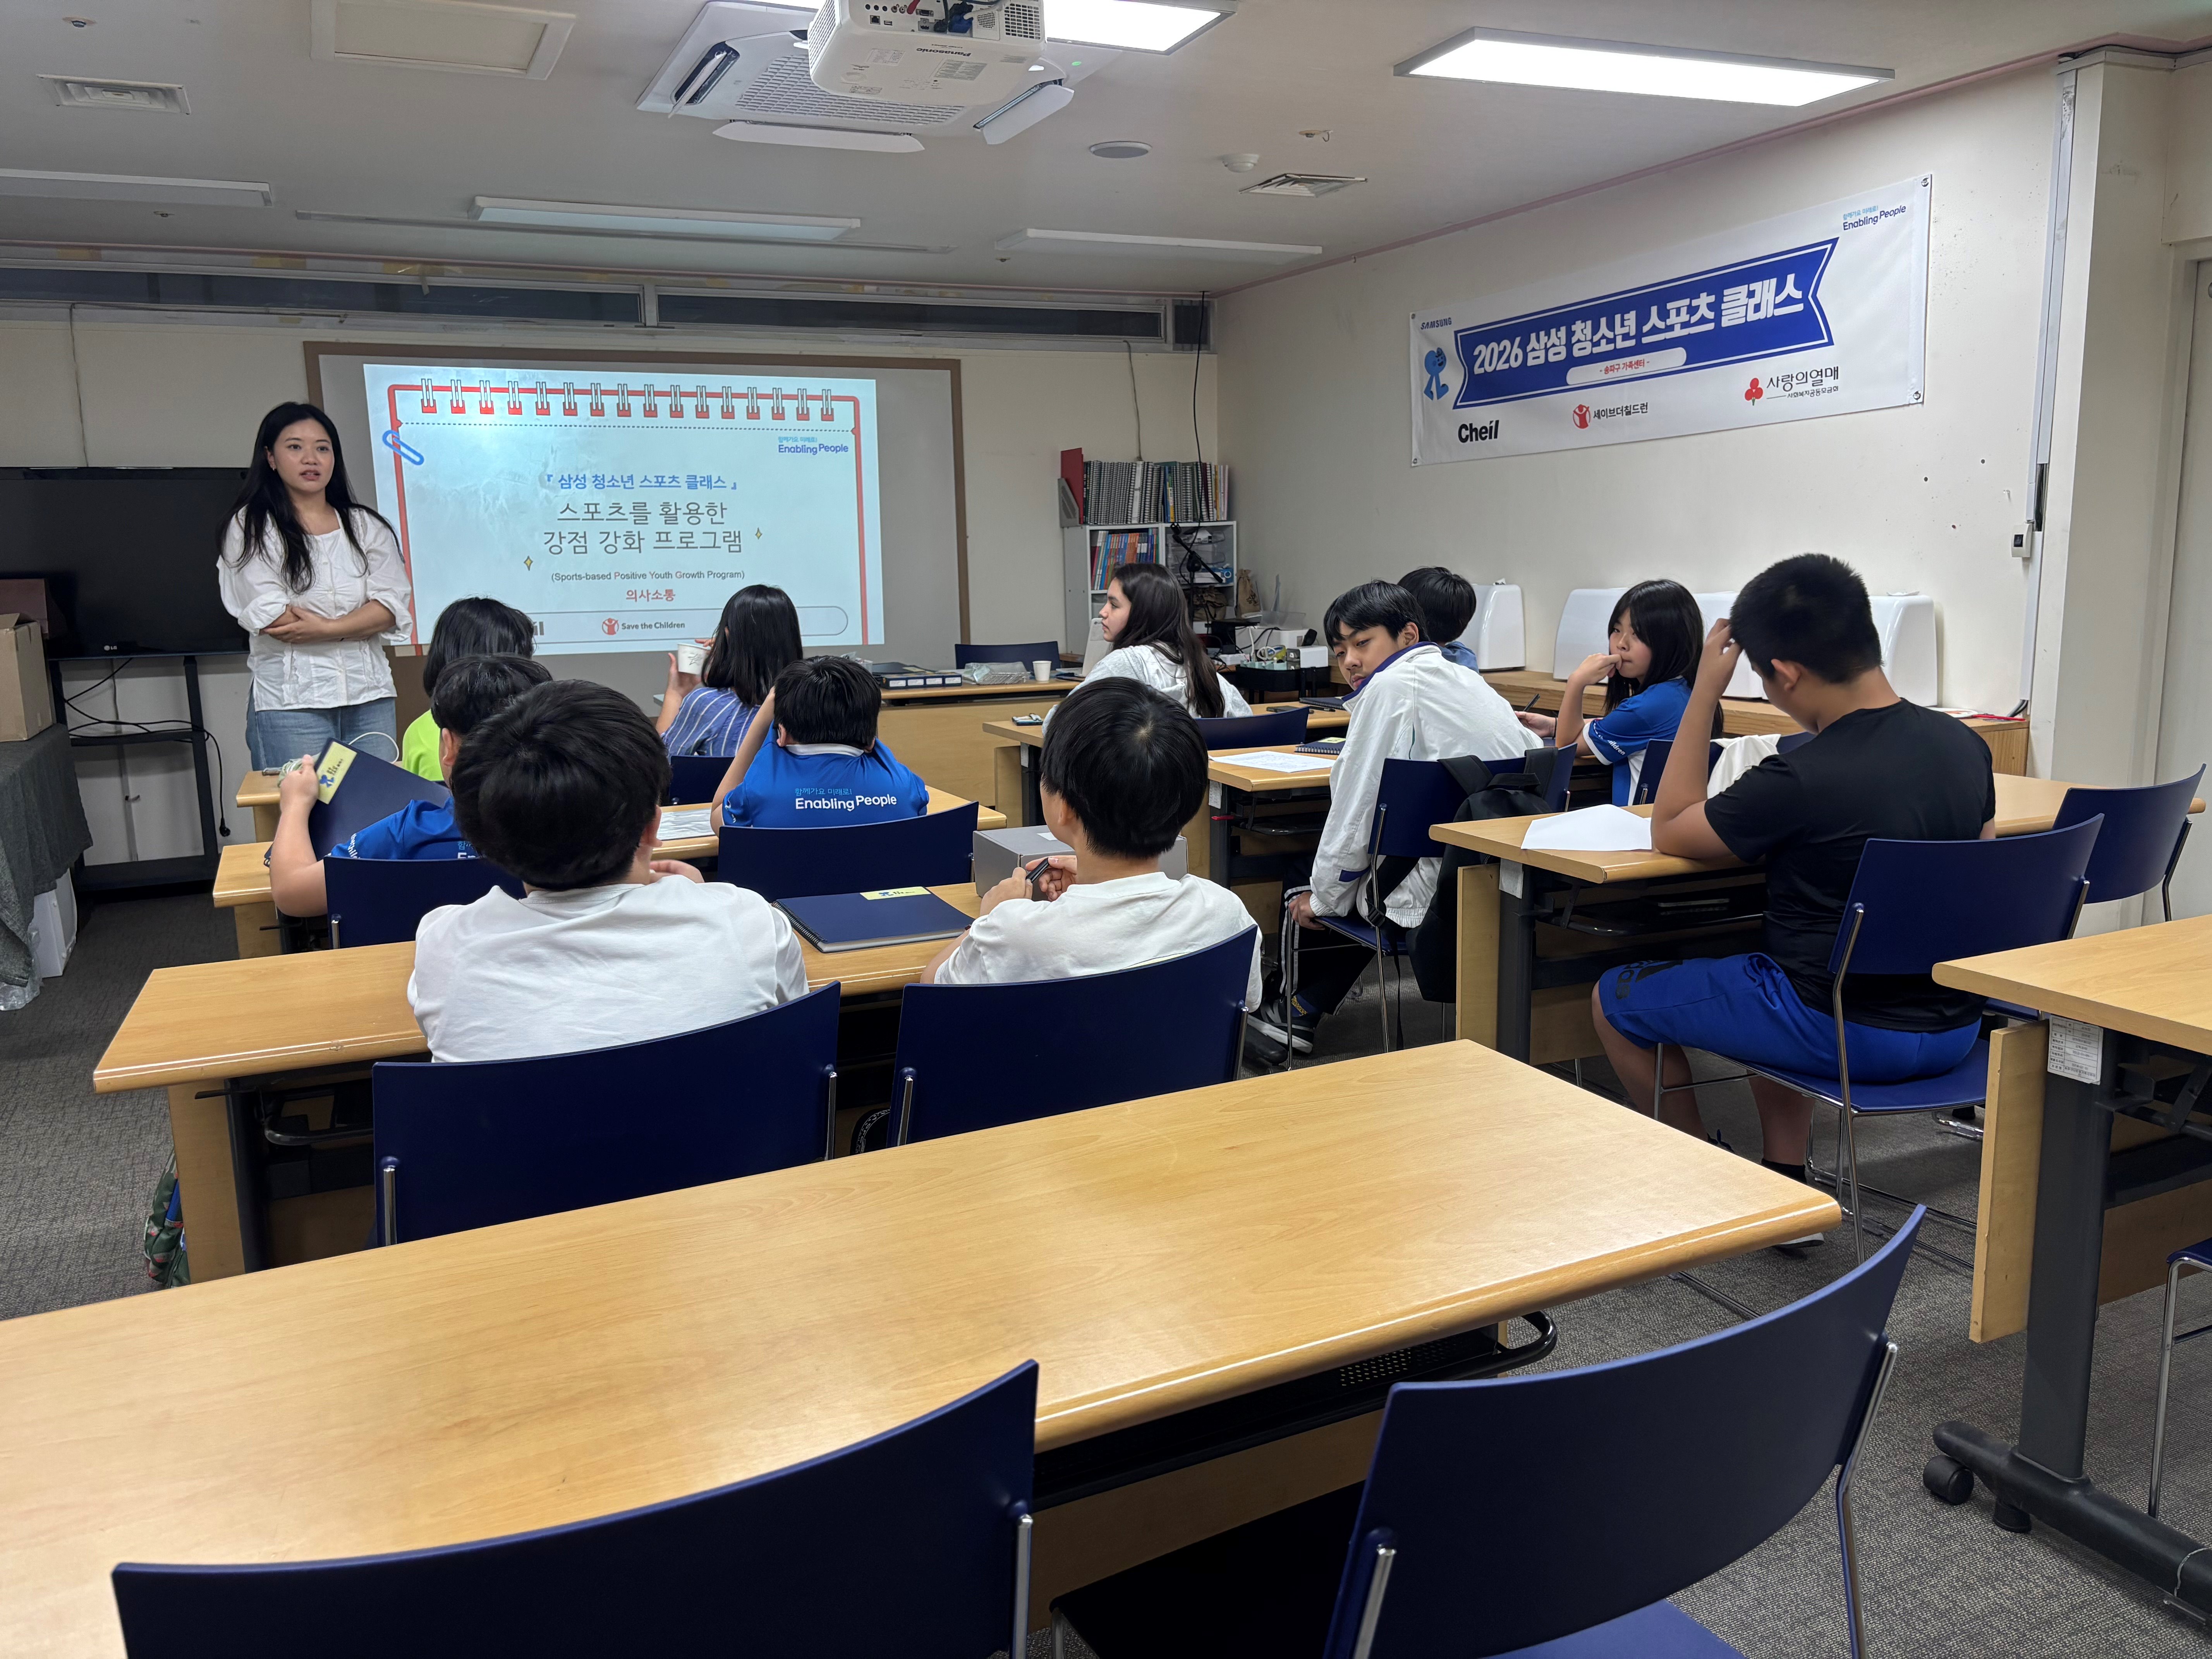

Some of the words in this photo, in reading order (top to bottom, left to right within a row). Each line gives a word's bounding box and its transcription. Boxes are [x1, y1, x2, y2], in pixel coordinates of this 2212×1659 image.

[916, 48, 971, 57] Panasonic
[1843, 215, 1878, 230] Enabling
[1879, 205, 1906, 219] People
[1420, 317, 1452, 330] SAMSUNG
[1473, 337, 1523, 374] 2026
[1527, 326, 1566, 366] 삼성
[1571, 310, 1636, 357] 청소년
[1642, 292, 1715, 343] 스포츠
[1721, 273, 1804, 327] 클래스
[1604, 364, 1621, 374] 송파구
[1622, 359, 1645, 371] 가족센터
[1766, 366, 1839, 392] 사랑의열매
[1787, 386, 1839, 398] 사회복지공동모금회
[1593, 402, 1648, 419] 세이브더칠드런
[1458, 420, 1499, 443] Cheil
[778, 445, 817, 455] Enabling
[819, 444, 848, 453] People
[558, 474, 587, 489] 삼성
[592, 474, 634, 489] 청소년
[639, 475, 681, 488] 스포츠
[685, 474, 727, 489] 클래스
[557, 502, 651, 525] 스포츠를
[659, 502, 727, 525] 활용한
[544, 531, 588, 555] 강점
[599, 531, 645, 554] 강화
[653, 531, 742, 553] 프로그램
[551, 572, 611, 582] (Sports-based
[614, 572, 647, 580] Positive
[649, 571, 673, 579] Youth
[675, 571, 704, 579] Growth
[707, 570, 745, 580] Program)
[626, 589, 676, 602] 의사소통
[654, 622, 685, 630] Children
[795, 788, 826, 796] 함께가요
[795, 798, 854, 811] Enabling
[855, 794, 897, 807] People
